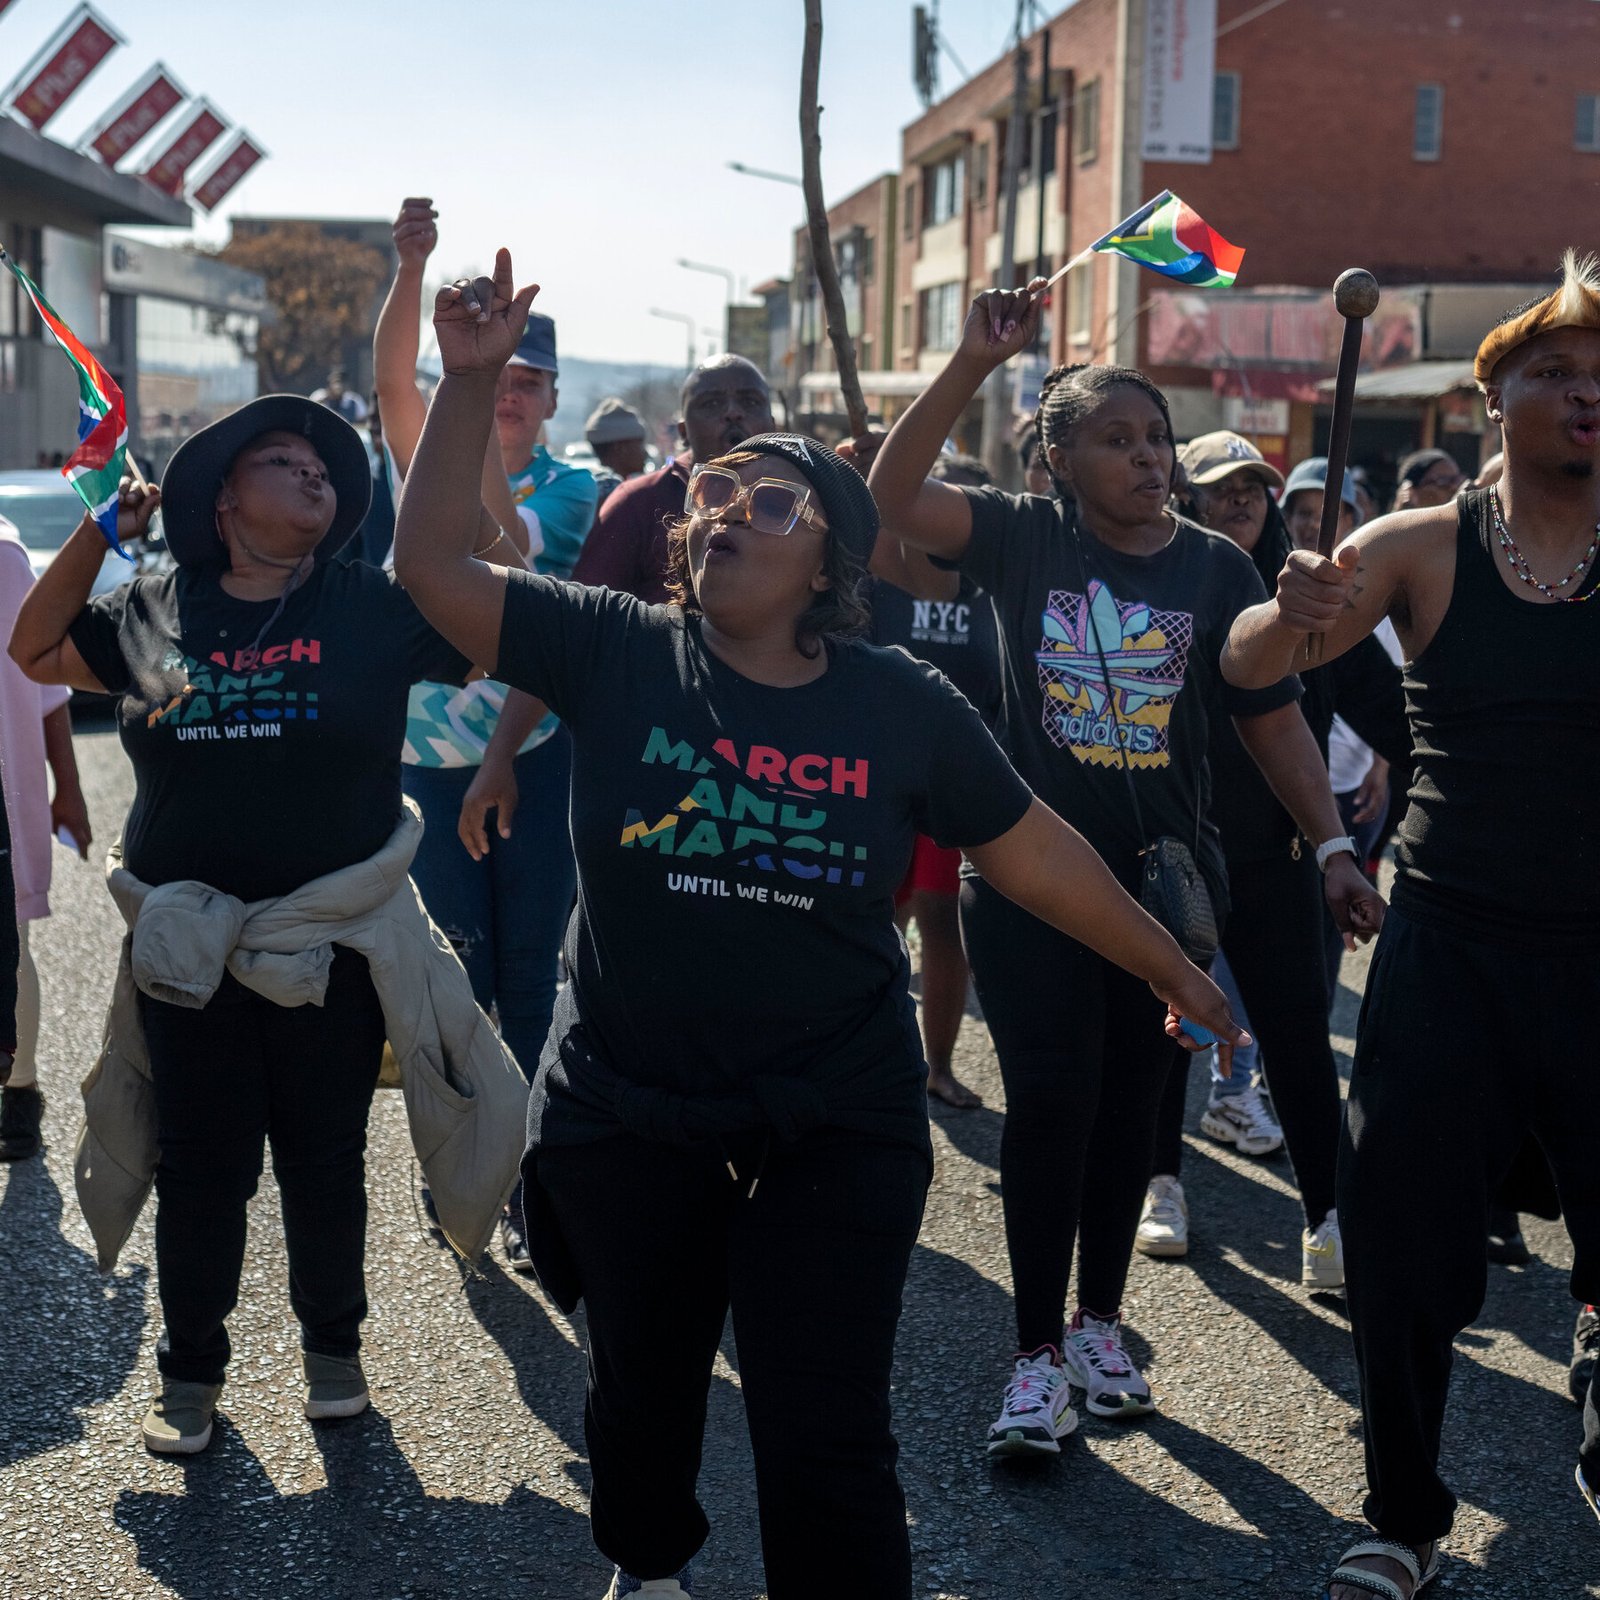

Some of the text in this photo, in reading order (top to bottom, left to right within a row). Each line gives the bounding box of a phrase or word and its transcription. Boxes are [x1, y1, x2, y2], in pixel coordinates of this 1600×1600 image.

[182, 671, 284, 694] AND
[176, 723, 281, 741] UNTIL WE WIN
[1054, 711, 1155, 752] adidas
[641, 726, 869, 799] MARCH
[674, 778, 827, 831] AND
[620, 808, 868, 887] MARCH
[667, 872, 814, 911] UNTIL WE WIN
